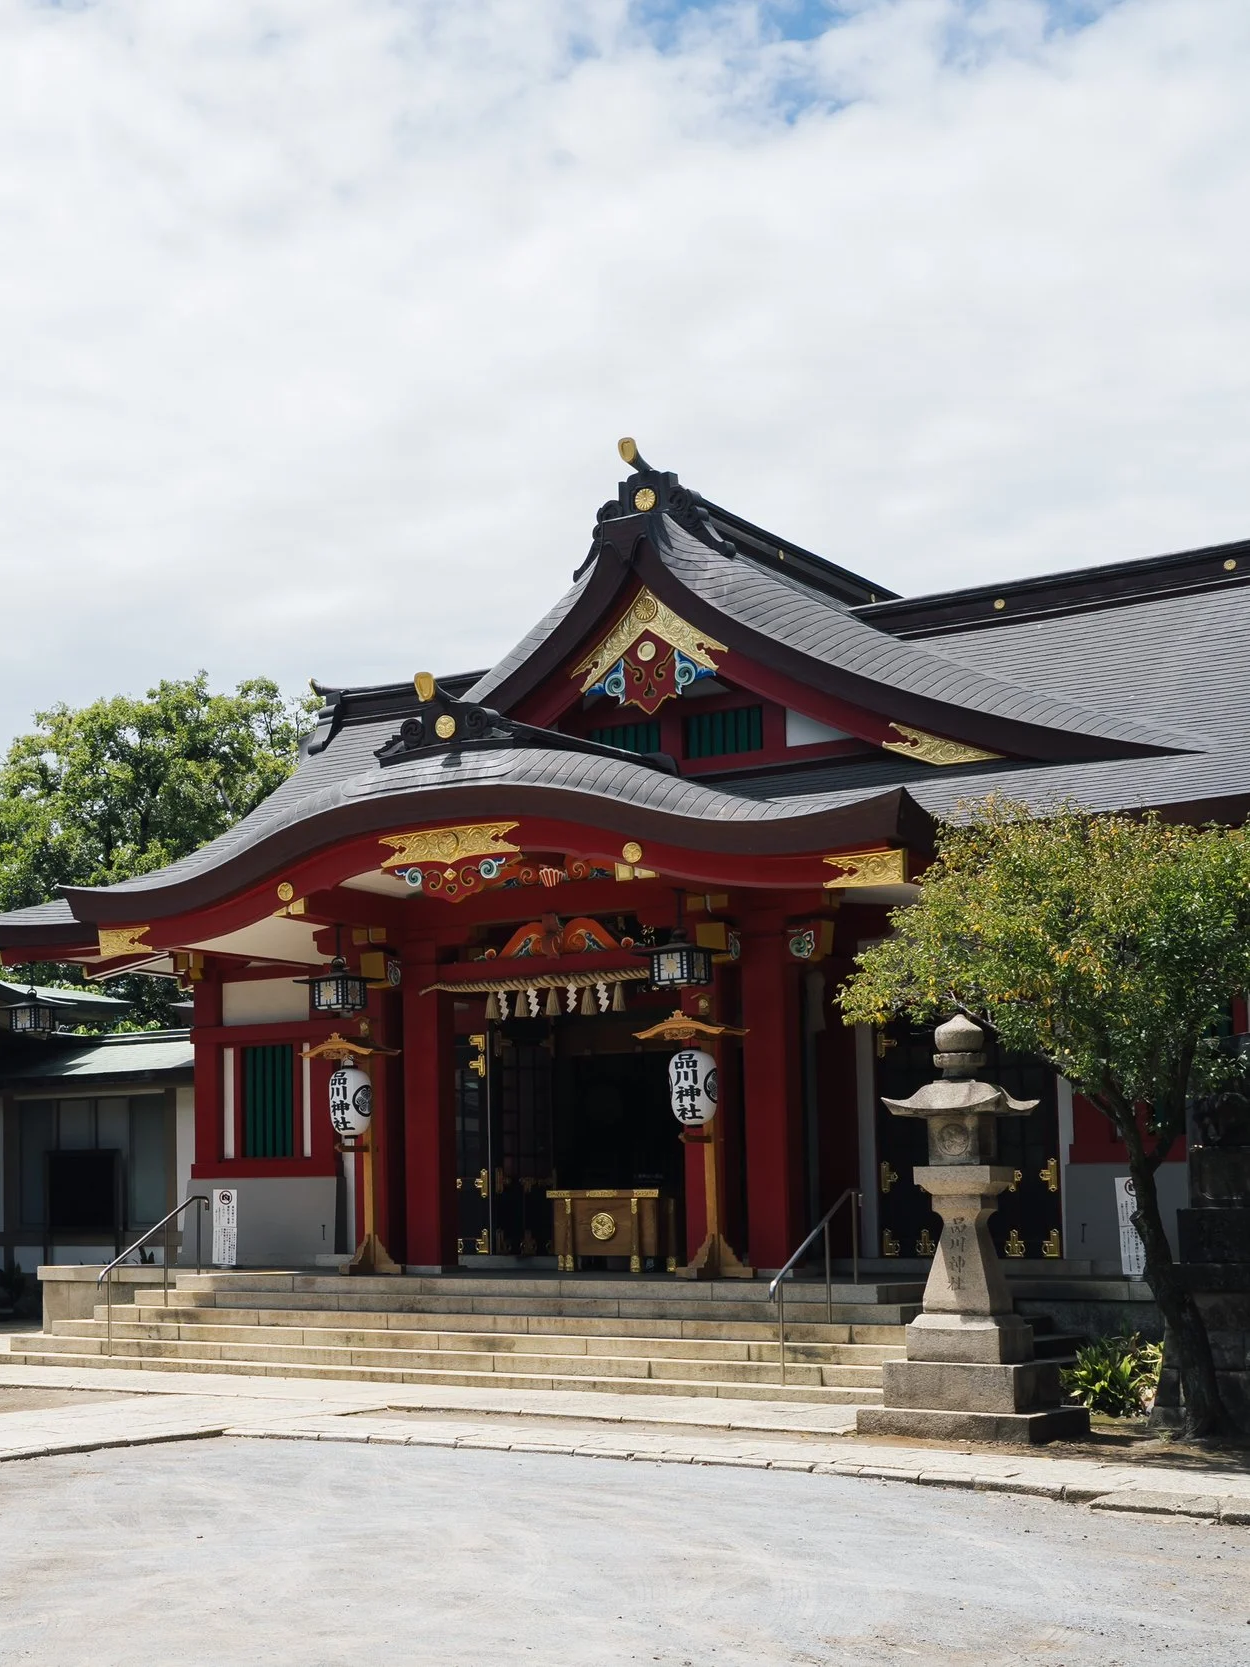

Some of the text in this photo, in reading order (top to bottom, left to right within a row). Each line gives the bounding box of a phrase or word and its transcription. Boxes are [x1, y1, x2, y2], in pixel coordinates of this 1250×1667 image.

[331, 1072, 356, 1131] 品川神社
[674, 1053, 704, 1120] 品川神社
[947, 1216, 967, 1291] 品川神社
